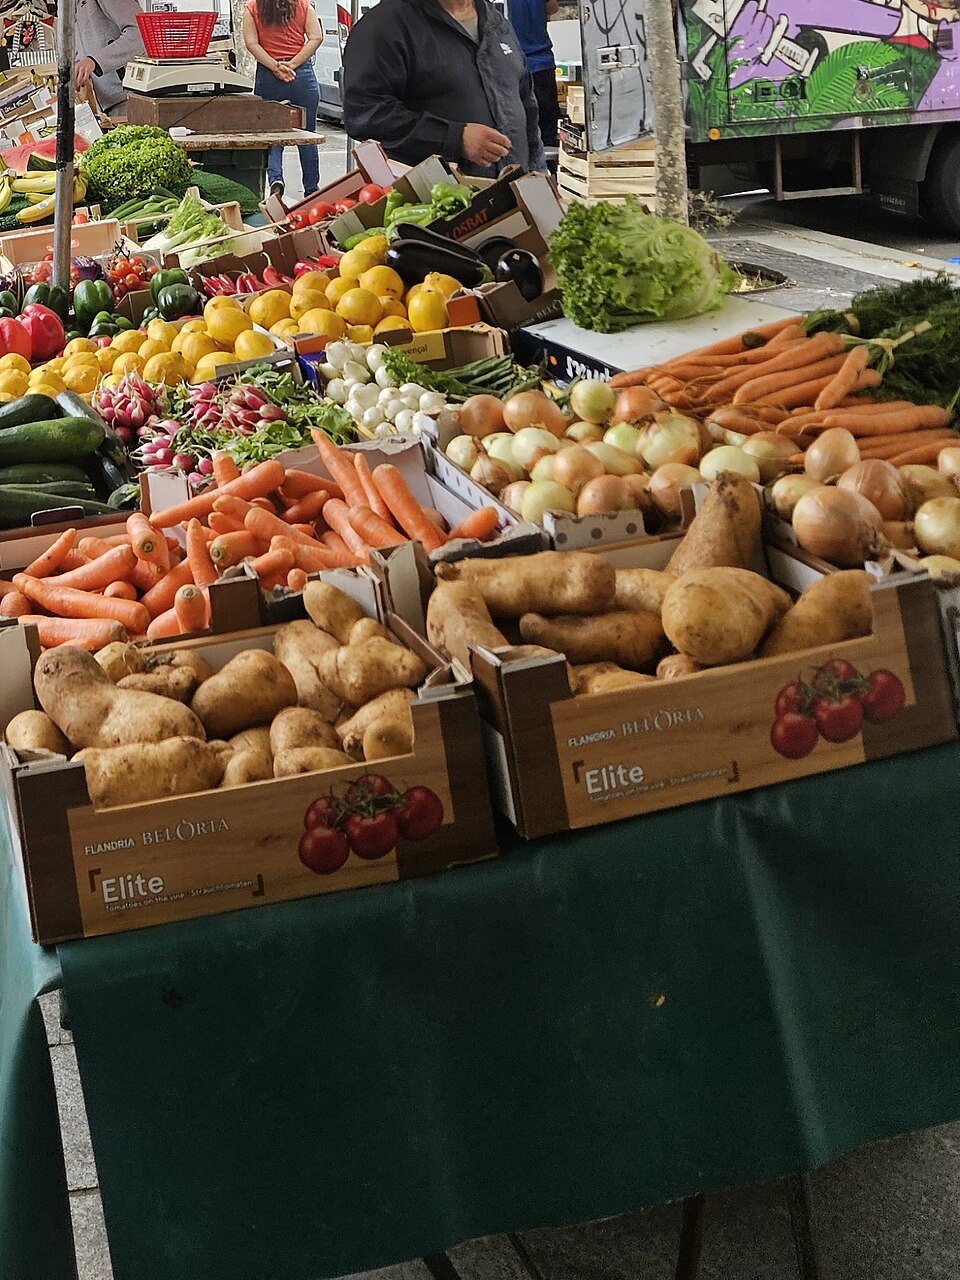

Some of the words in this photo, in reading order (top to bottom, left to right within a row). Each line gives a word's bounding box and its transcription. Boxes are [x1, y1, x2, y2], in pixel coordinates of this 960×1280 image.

[402, 344, 428, 357] vençal
[568, 730, 617, 748] FLANDRIA
[585, 764, 645, 794] Elite
[84, 838, 135, 856] FLANDRIA
[102, 873, 165, 903] Elite
[154, 893, 169, 904] the
